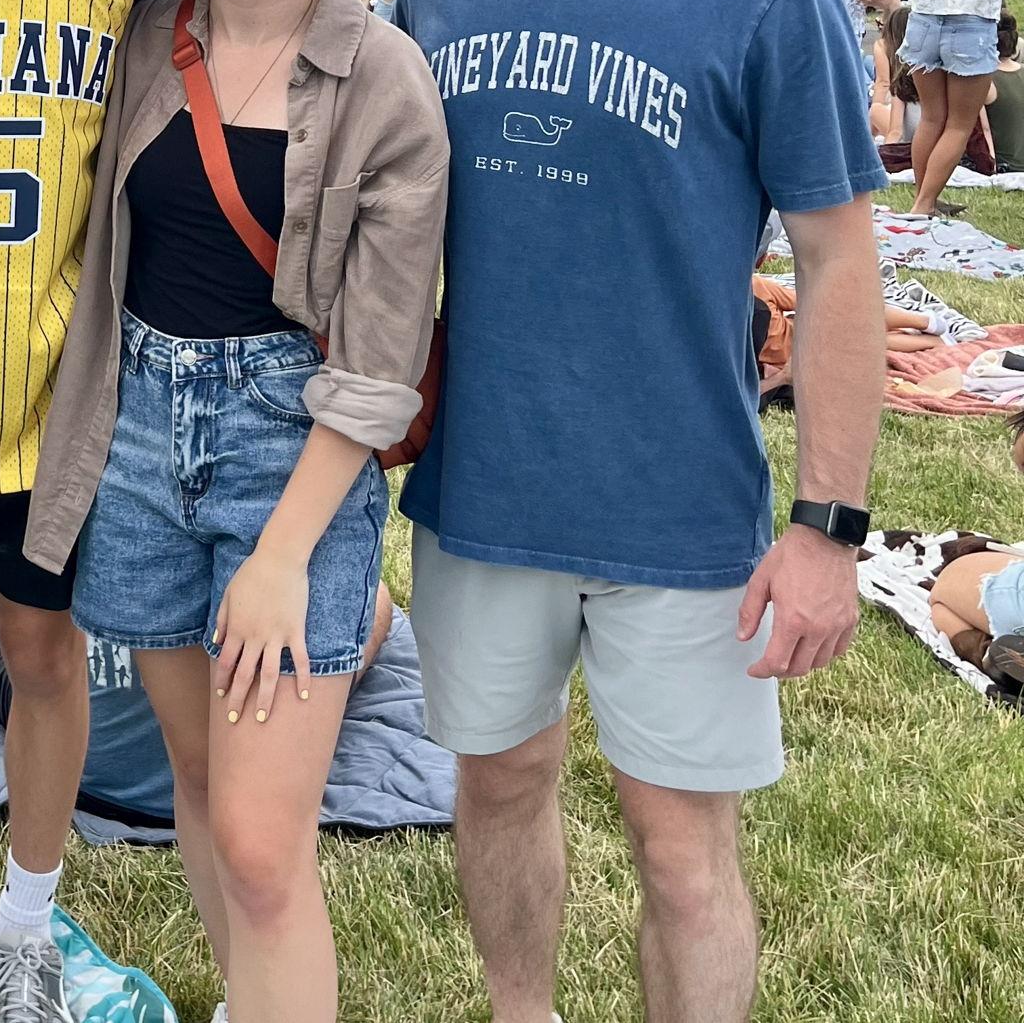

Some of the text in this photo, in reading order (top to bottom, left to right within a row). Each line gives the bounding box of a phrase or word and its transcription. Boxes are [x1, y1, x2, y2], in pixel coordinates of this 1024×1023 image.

[587, 41, 688, 150] VINES
[475, 156, 588, 186] EST. 1998
